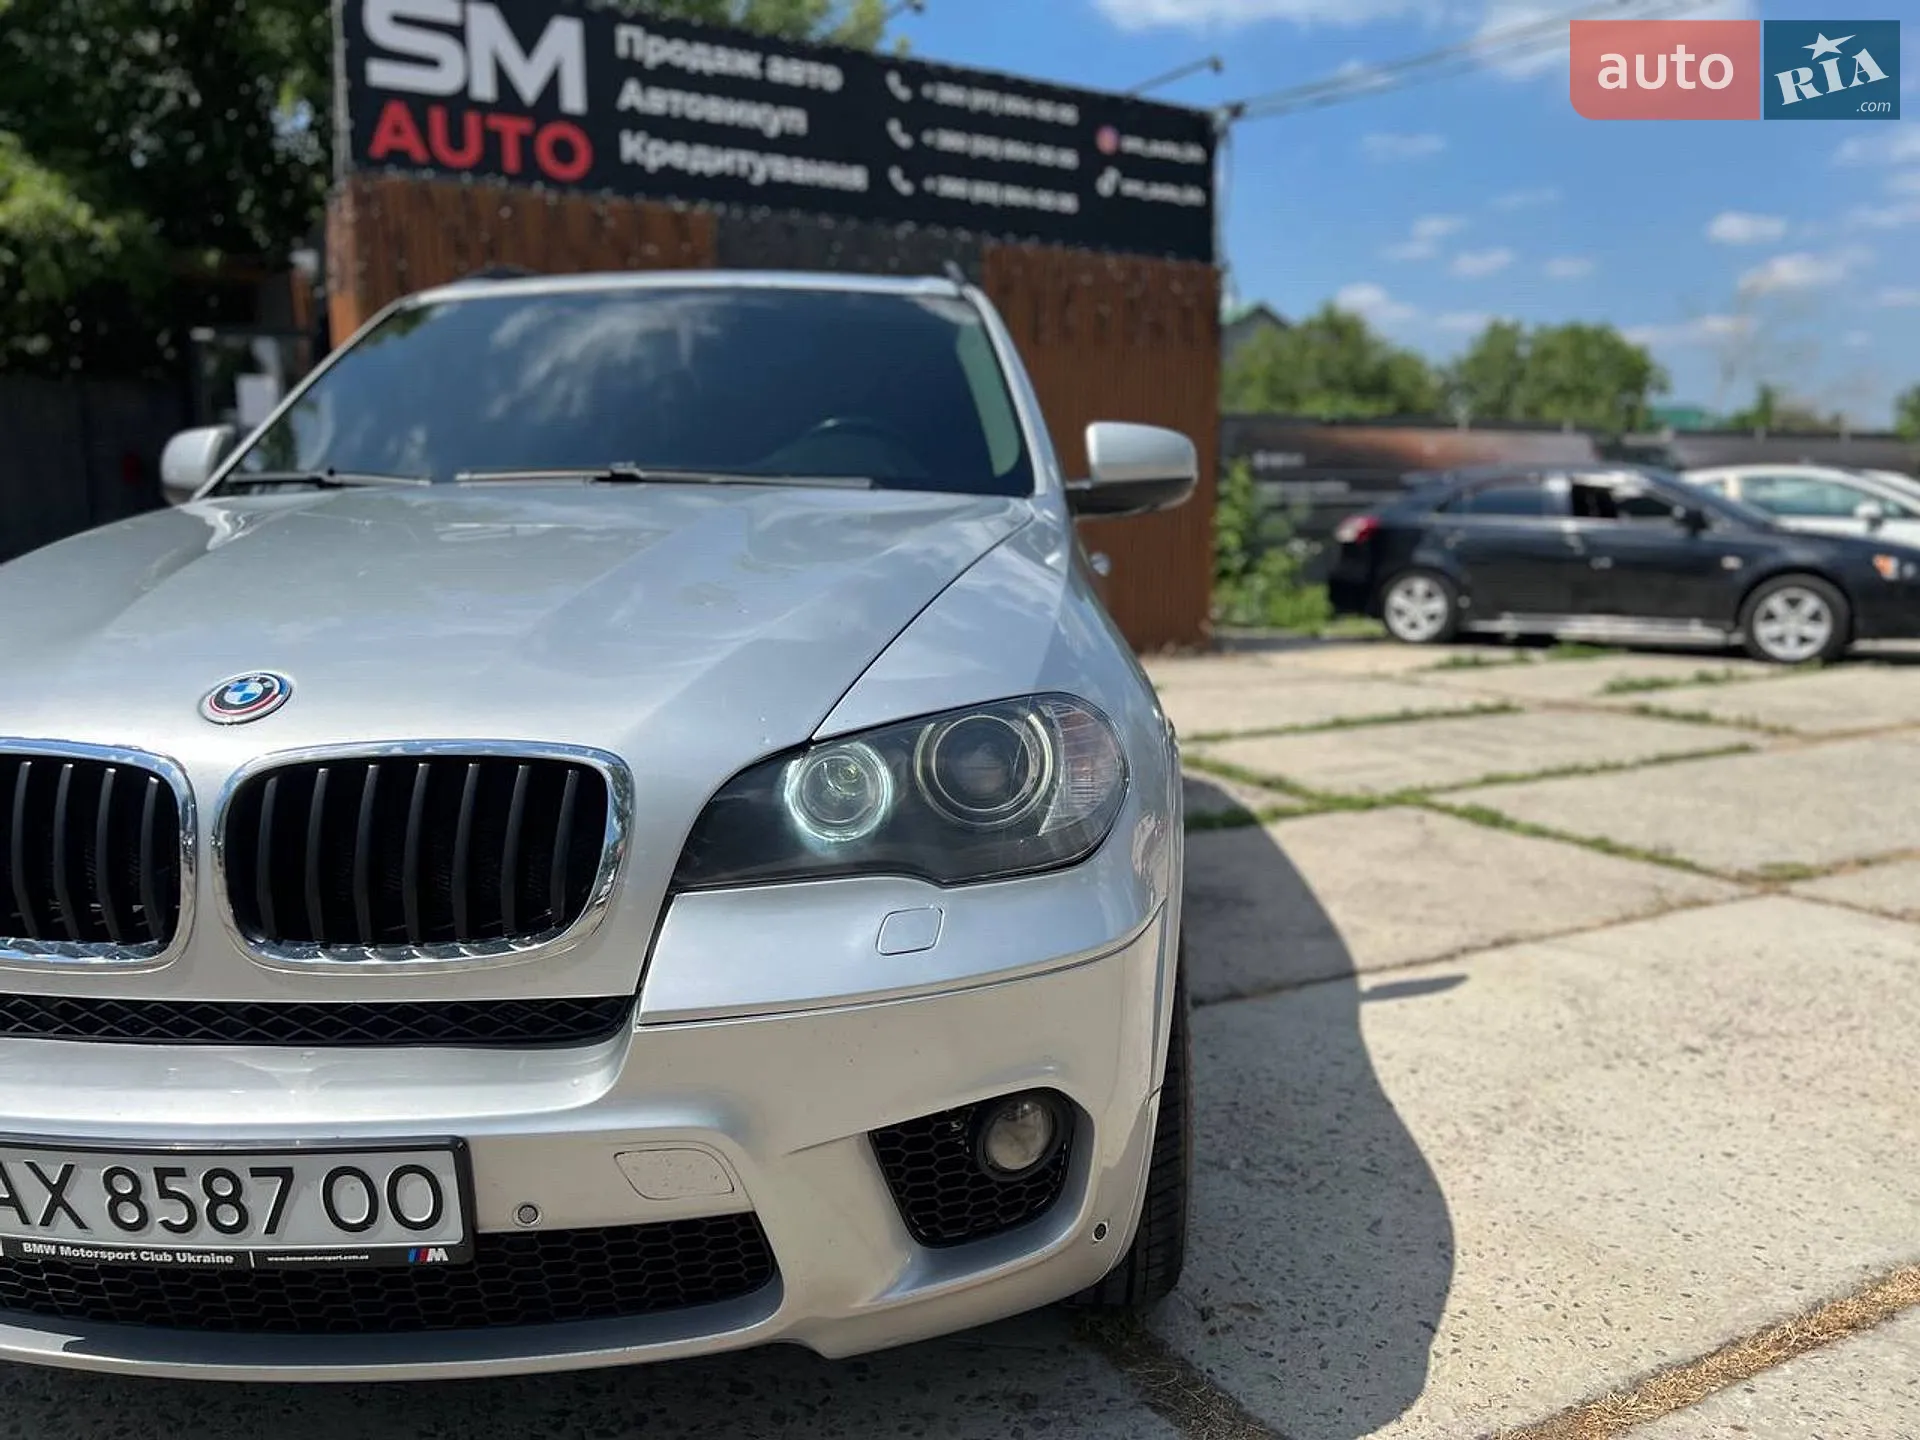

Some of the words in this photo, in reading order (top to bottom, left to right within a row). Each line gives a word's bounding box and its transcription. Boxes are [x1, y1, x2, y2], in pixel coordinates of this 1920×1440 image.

[362, 0, 588, 116] SM
[614, 23, 763, 80] Продаж
[765, 53, 844, 93] авто
[368, 98, 594, 183] AUTO
[616, 77, 809, 139] Автовикуп
[619, 129, 869, 193] Кредитування
[103, 1166, 294, 1235] 8587
[22, 1242, 56, 1256] BMW
[59, 1246, 138, 1261] Motorsport
[140, 1250, 173, 1262] Club
[176, 1252, 234, 1264] Ukraine
